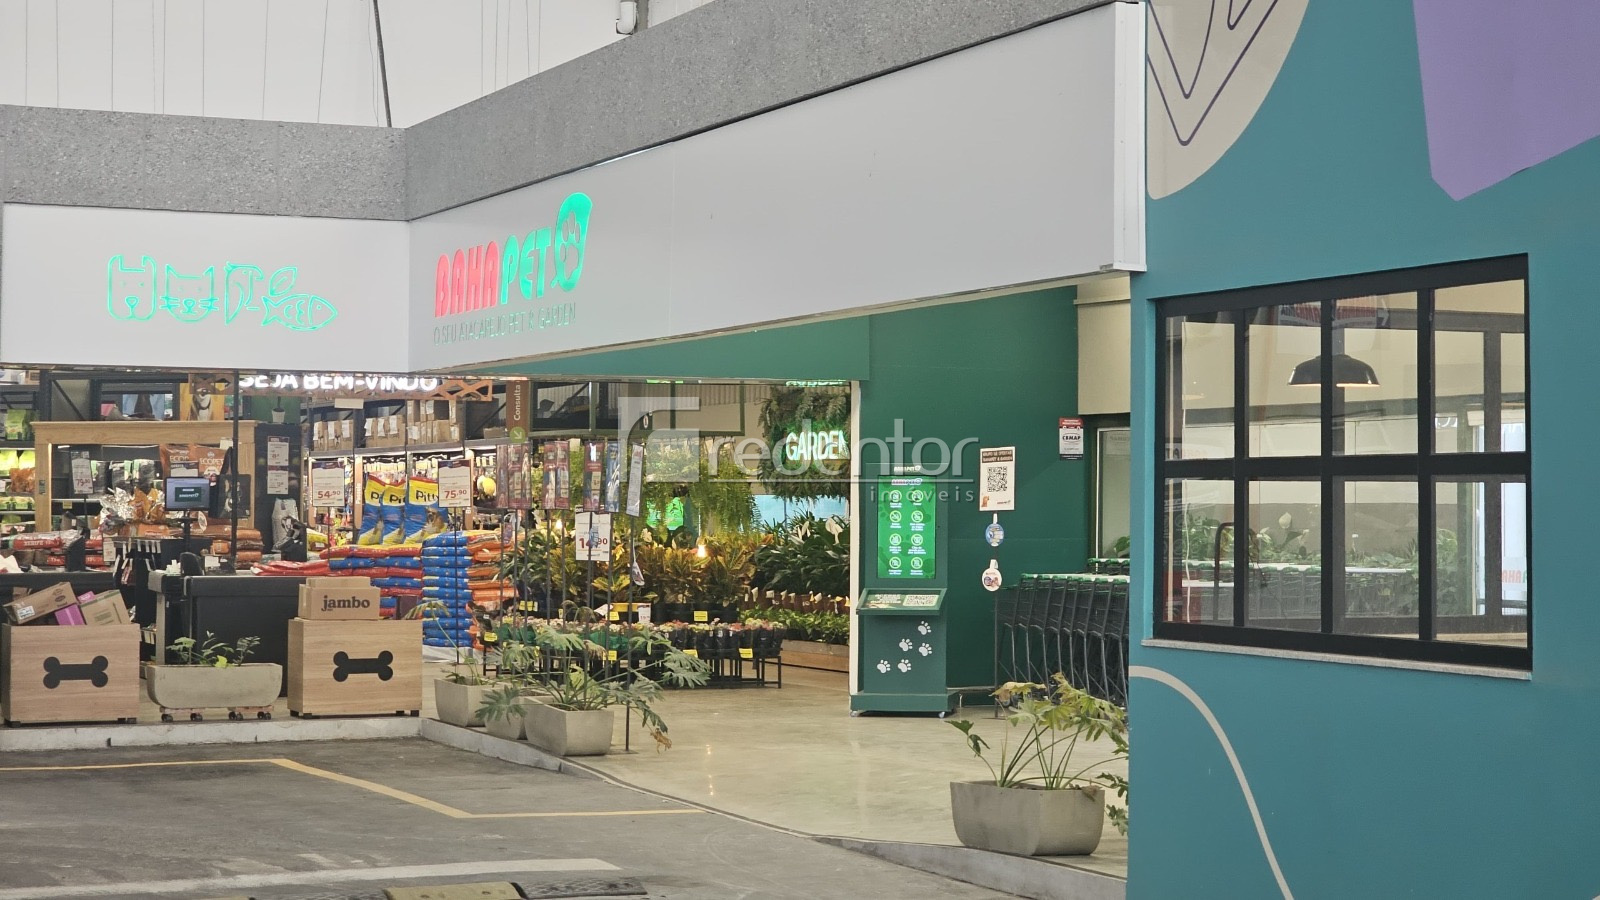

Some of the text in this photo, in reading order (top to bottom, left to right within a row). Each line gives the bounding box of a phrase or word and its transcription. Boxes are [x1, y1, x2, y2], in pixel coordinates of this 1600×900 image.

[435, 228, 552, 318] BAHAPET
[434, 326, 441, 346] O
[442, 322, 457, 345] SEU
[509, 311, 526, 334] PET
[528, 308, 535, 331] &
[538, 302, 576, 329] GARDEN
[239, 374, 437, 391] SEJA BEM-VINDO
[513, 384, 521, 421] Consulta
[785, 429, 848, 461] GARDEN
[321, 594, 370, 611] jambo
